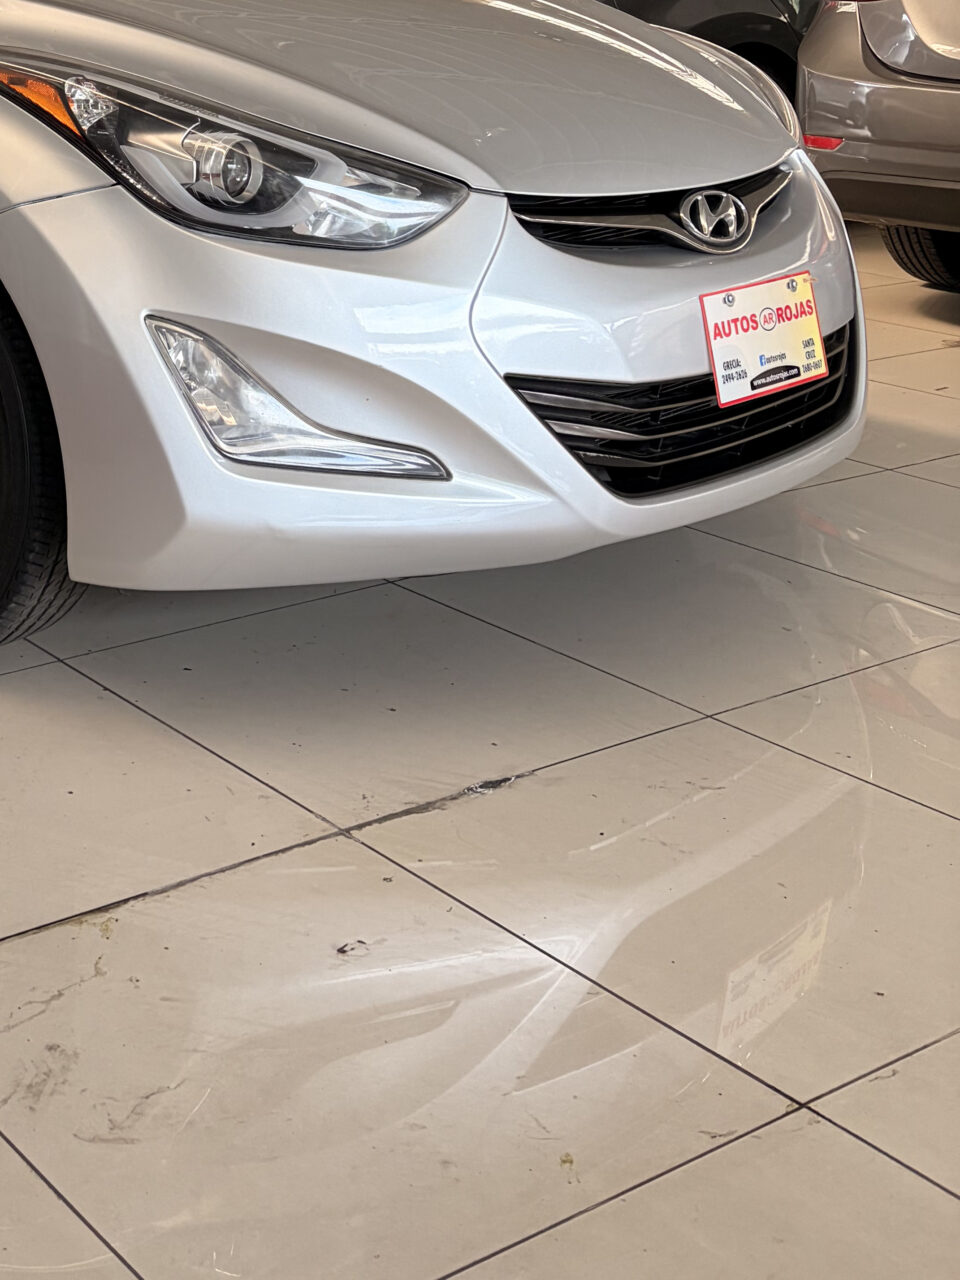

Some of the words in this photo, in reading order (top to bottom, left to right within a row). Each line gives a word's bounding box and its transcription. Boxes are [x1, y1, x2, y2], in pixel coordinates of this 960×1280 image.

[713, 313, 759, 341] AUTOS
[762, 312, 775, 326] AR
[775, 299, 814, 324] ROJAS
[801, 337, 816, 349] SANTA
[765, 352, 787, 365] autosrojas
[805, 349, 817, 360] CRUZ
[722, 358, 742, 372] GRECIA:
[752, 368, 800, 387] www.autosrojas.com
